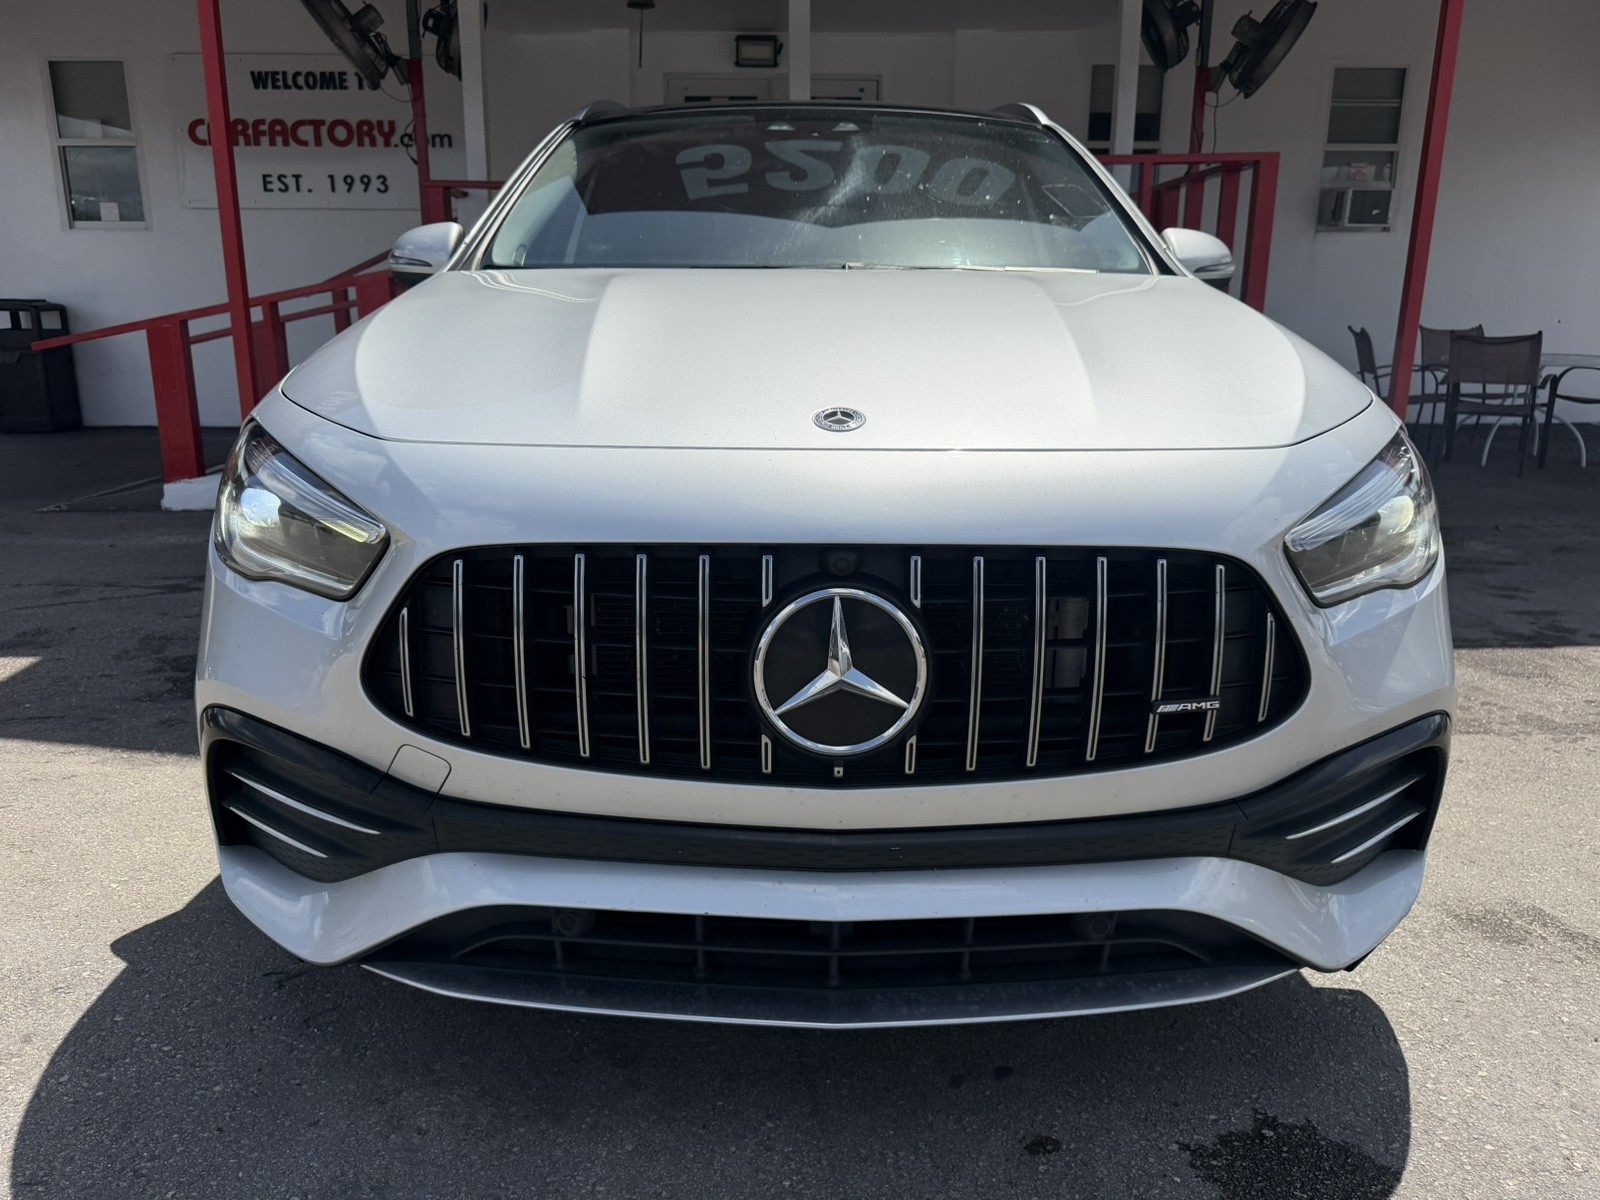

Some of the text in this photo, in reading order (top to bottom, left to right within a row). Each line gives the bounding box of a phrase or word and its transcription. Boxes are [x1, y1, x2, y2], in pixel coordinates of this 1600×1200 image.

[250, 71, 348, 90] WELCOME
[188, 118, 453, 148] CRFACTORY.cm
[262, 174, 389, 193] EST. 1993
[1177, 701, 1220, 711] AMG
